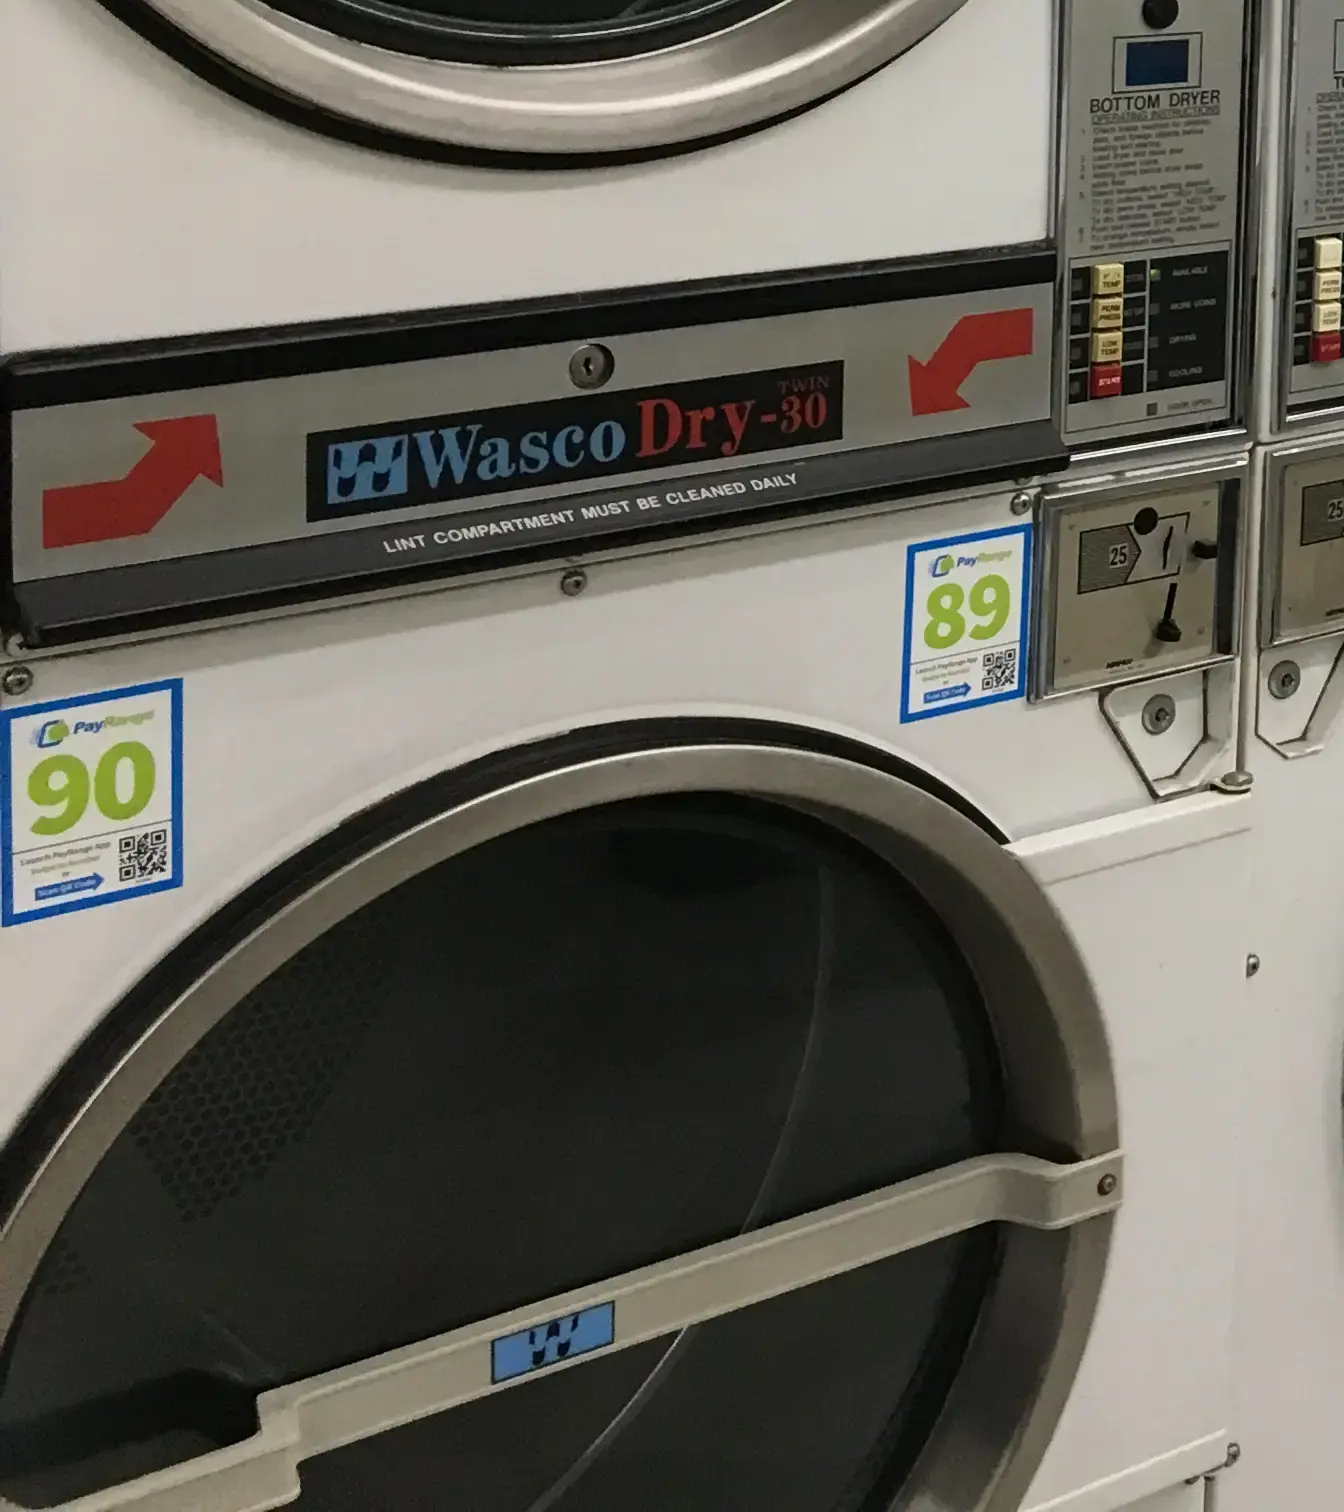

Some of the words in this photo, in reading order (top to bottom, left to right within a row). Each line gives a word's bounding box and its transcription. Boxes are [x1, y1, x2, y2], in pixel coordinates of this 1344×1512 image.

[1089, 93, 1161, 114] BOTTOM
[1168, 89, 1221, 108] DRYER
[778, 372, 831, 396] TWIN
[412, 418, 628, 491] Wasco
[635, 390, 830, 459] Dry-30
[382, 533, 429, 556] LINT
[432, 508, 578, 548] COMPARTMENT
[580, 499, 632, 522] MUST
[636, 493, 663, 512] BE
[664, 479, 749, 509] CLEANED
[749, 471, 801, 494] DAILY
[1328, 499, 1344, 523] 25
[956, 549, 1013, 568] PayRange
[1108, 544, 1128, 568] 25
[923, 573, 1011, 651] 89
[72, 708, 156, 735] PayRange
[26, 740, 157, 836] 90
